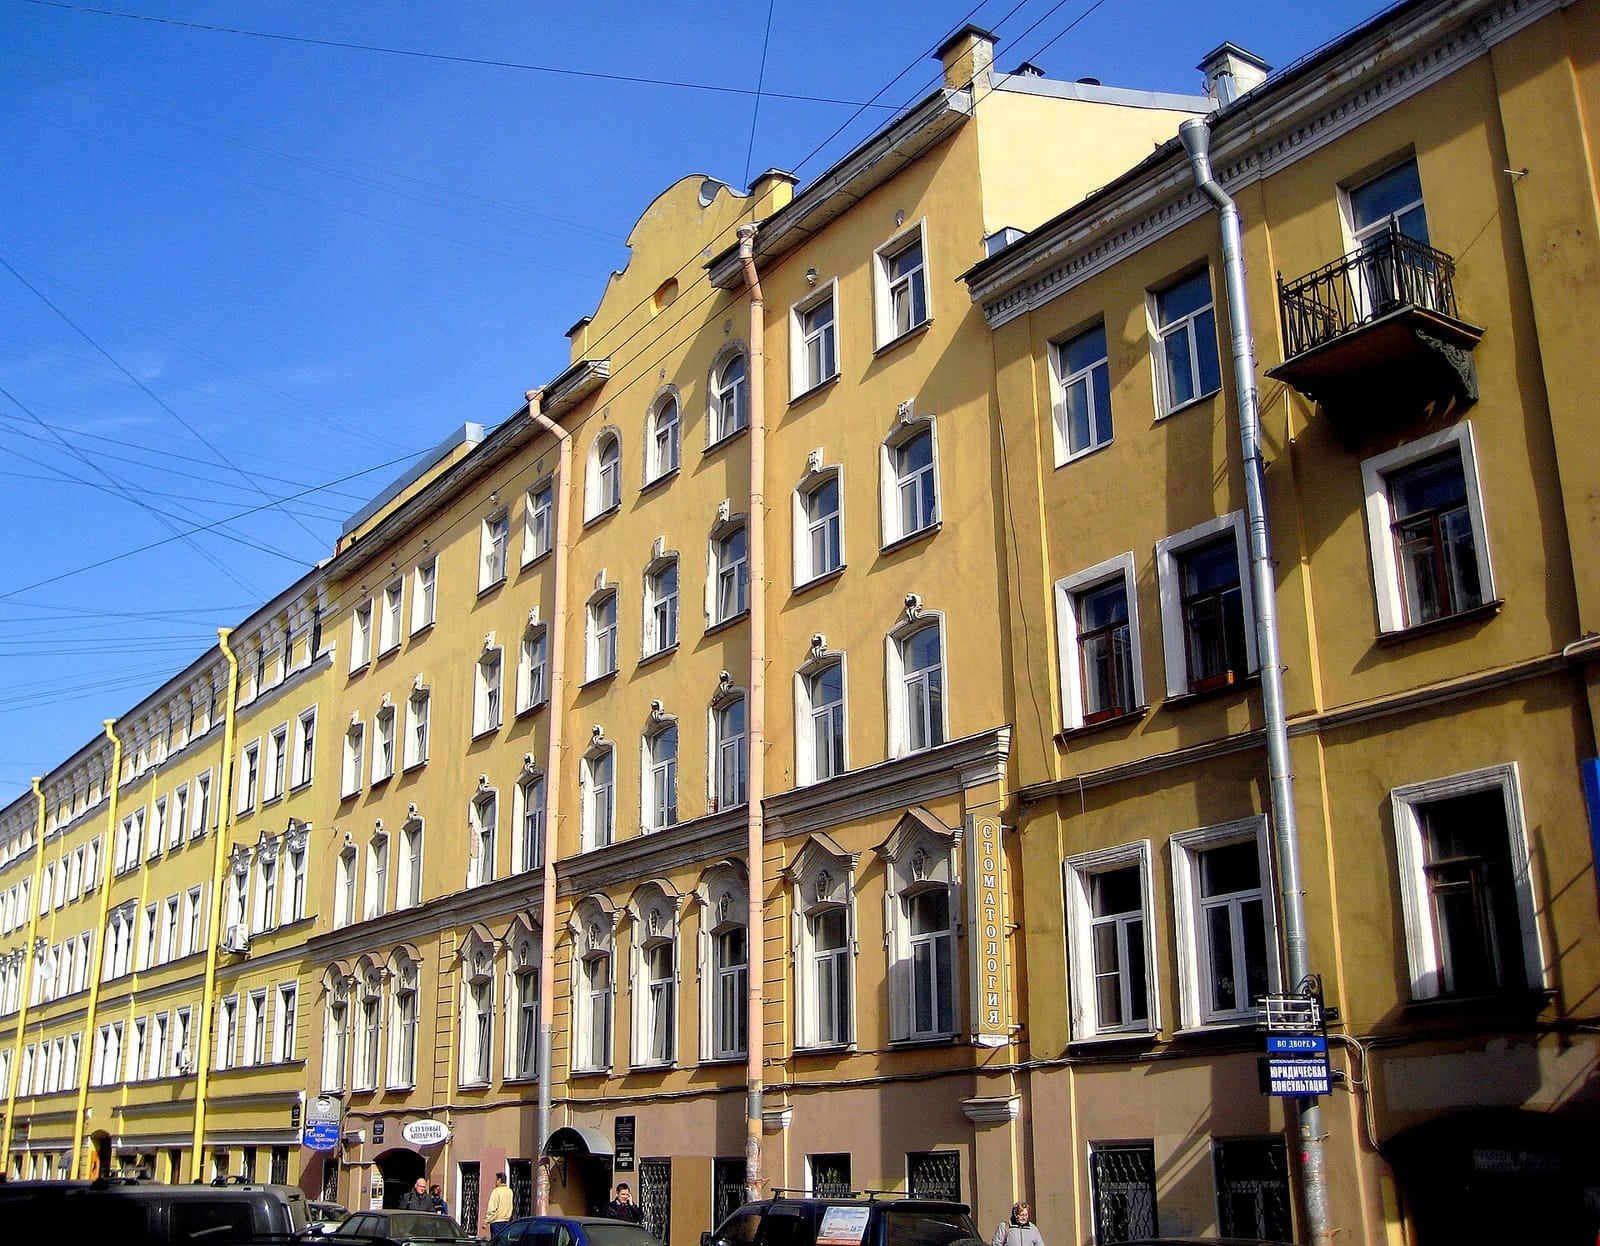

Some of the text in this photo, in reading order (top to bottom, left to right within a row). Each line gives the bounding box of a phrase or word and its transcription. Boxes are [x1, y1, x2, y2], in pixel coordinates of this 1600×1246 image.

[981, 824, 1000, 1024] СТОМАТОЛОГИЯ
[1277, 1039, 1311, 1049] ВО ДВОРЕ
[1270, 1066, 1327, 1079] ЮРИДИЧЕСКАЯ
[1271, 1080, 1328, 1093] КОНСУЛЬТАЦИЯ
